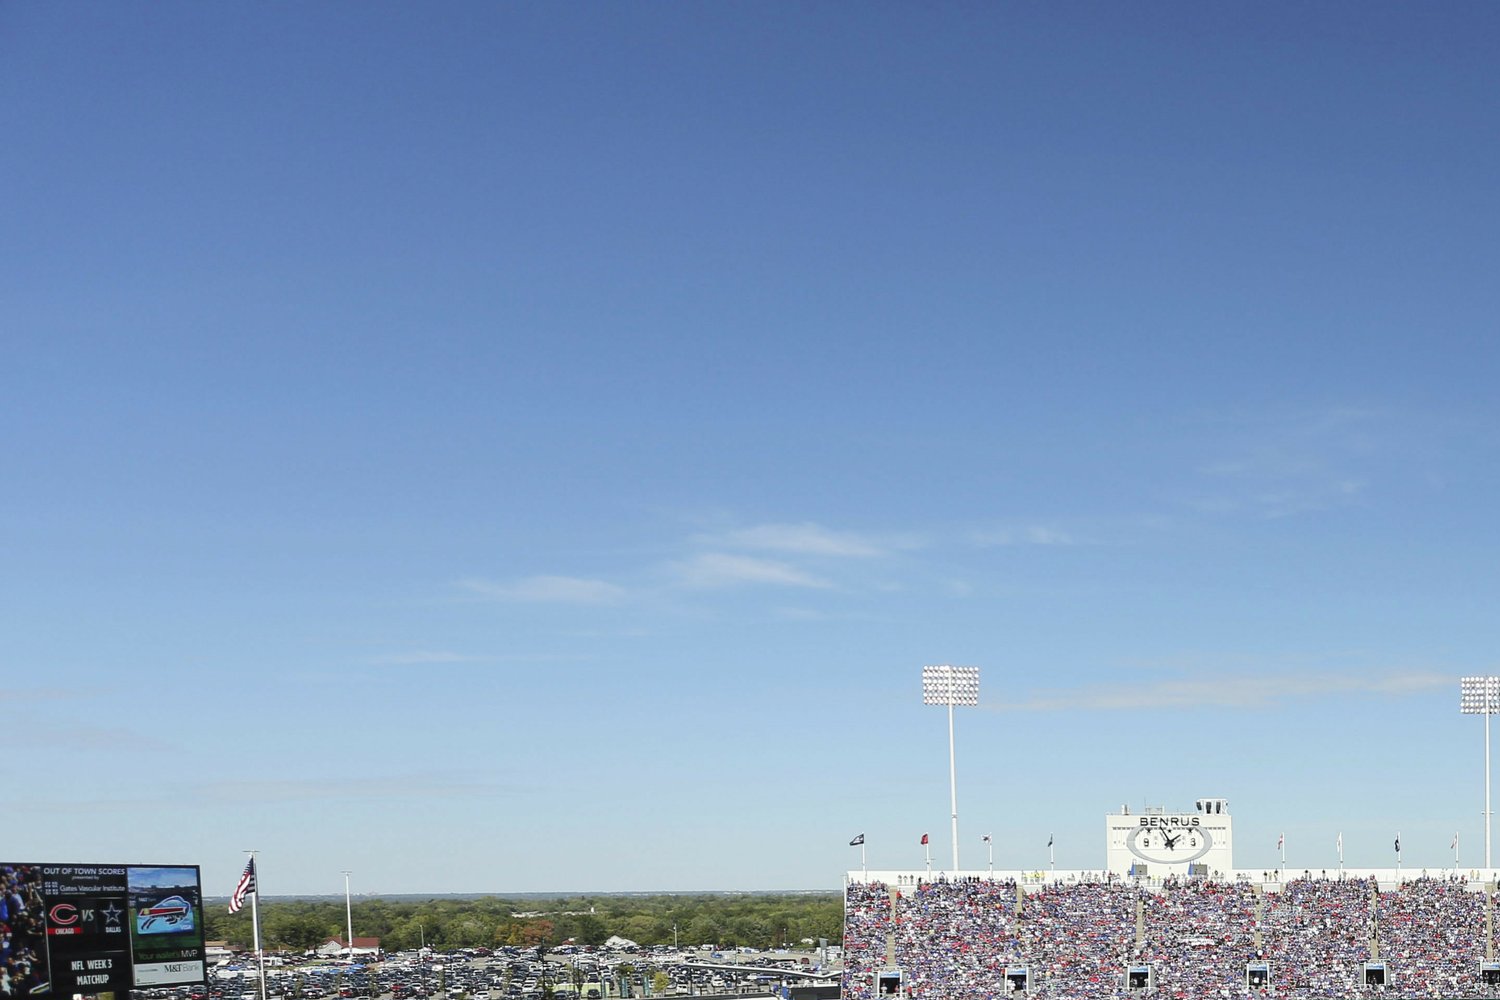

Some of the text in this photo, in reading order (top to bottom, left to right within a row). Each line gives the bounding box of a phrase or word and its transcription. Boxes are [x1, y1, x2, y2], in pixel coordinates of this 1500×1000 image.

[1140, 817, 1200, 826] BENRUS
[60, 885, 77, 893] Gates
[82, 909, 94, 922] VS
[71, 958, 113, 971] NFL WEEK 3
[183, 964, 200, 972] Bank
[76, 974, 110, 985] MATCHUP
